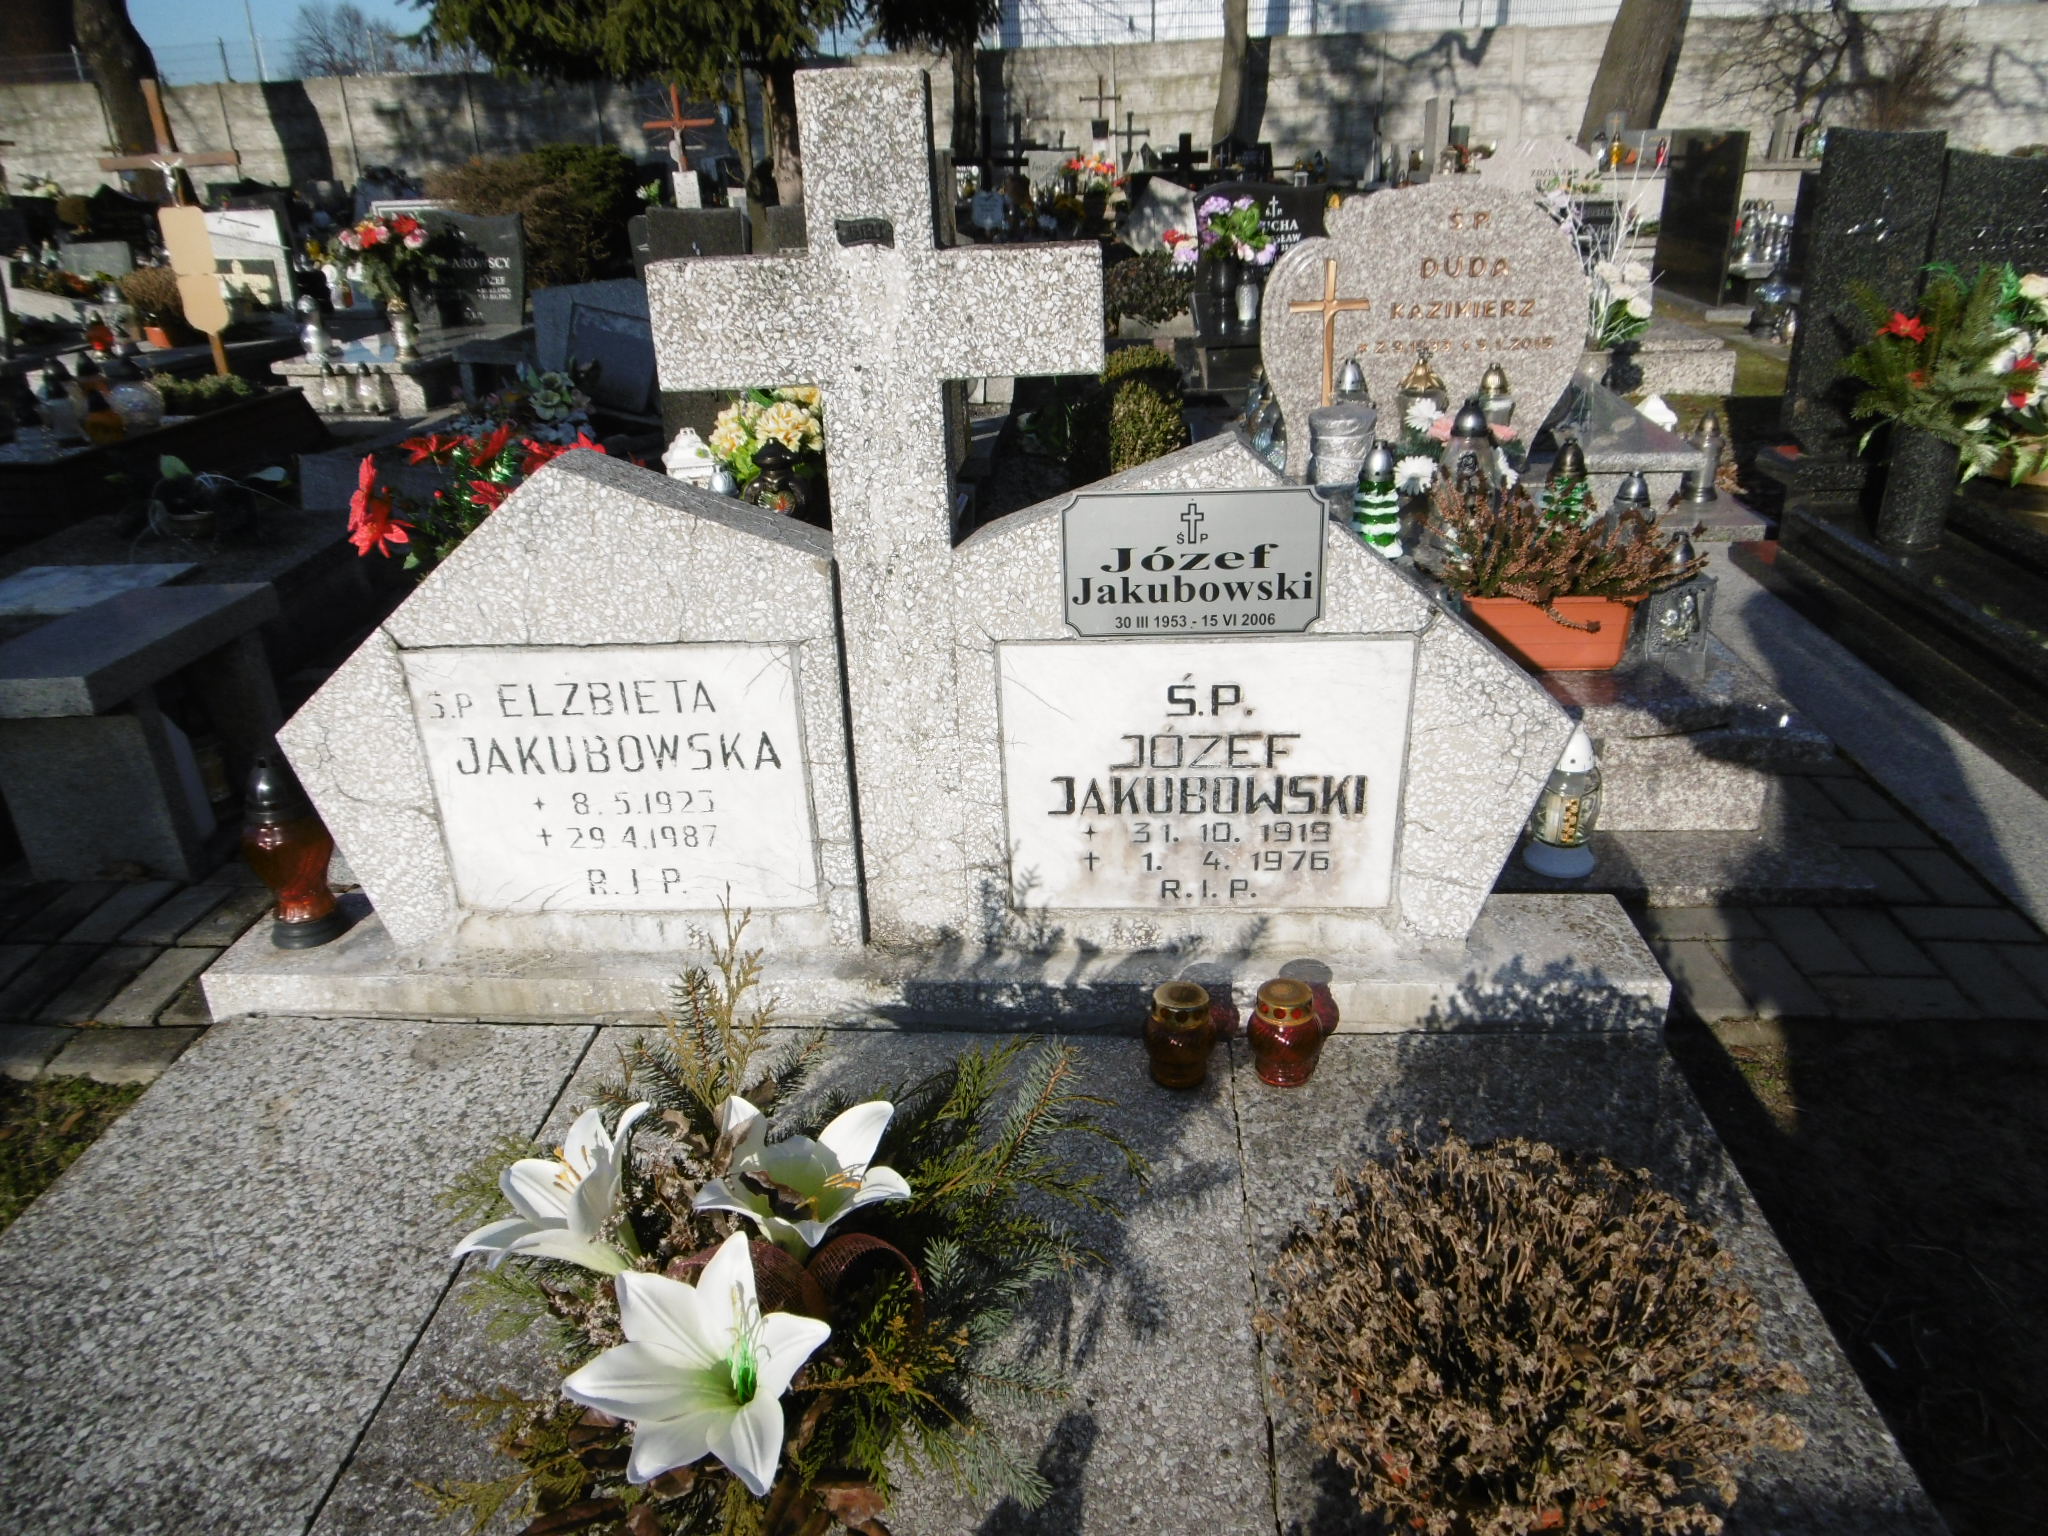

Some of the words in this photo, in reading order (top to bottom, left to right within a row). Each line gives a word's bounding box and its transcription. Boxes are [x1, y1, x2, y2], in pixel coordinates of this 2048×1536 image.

[1420, 256, 1509, 280] DUDA
[1389, 298, 1536, 320] KAZIMIERZ
[1176, 531, 1185, 545] Ś
[1199, 533, 1209, 544] P
[1100, 543, 1279, 573] Józef
[1072, 571, 1313, 606] Jakubowski
[1114, 617, 1132, 629] 30
[1136, 616, 1149, 629] III
[1153, 615, 1187, 628] 1953
[1201, 614, 1218, 627] 15
[1223, 613, 1237, 627] VI
[1241, 612, 1276, 627] 2006
[1166, 673, 1254, 718] Ś.P.
[456, 730, 782, 775] JAKUBOWSKA
[1109, 726, 1301, 771] JÓZEF
[1047, 775, 1368, 818] JAKUBOWSKI
[1133, 822, 1179, 843] 31.
[1201, 822, 1241, 842] 10.
[1260, 821, 1331, 843] 1919
[1142, 851, 1162, 872] 1.
[1252, 850, 1330, 872] 1976
